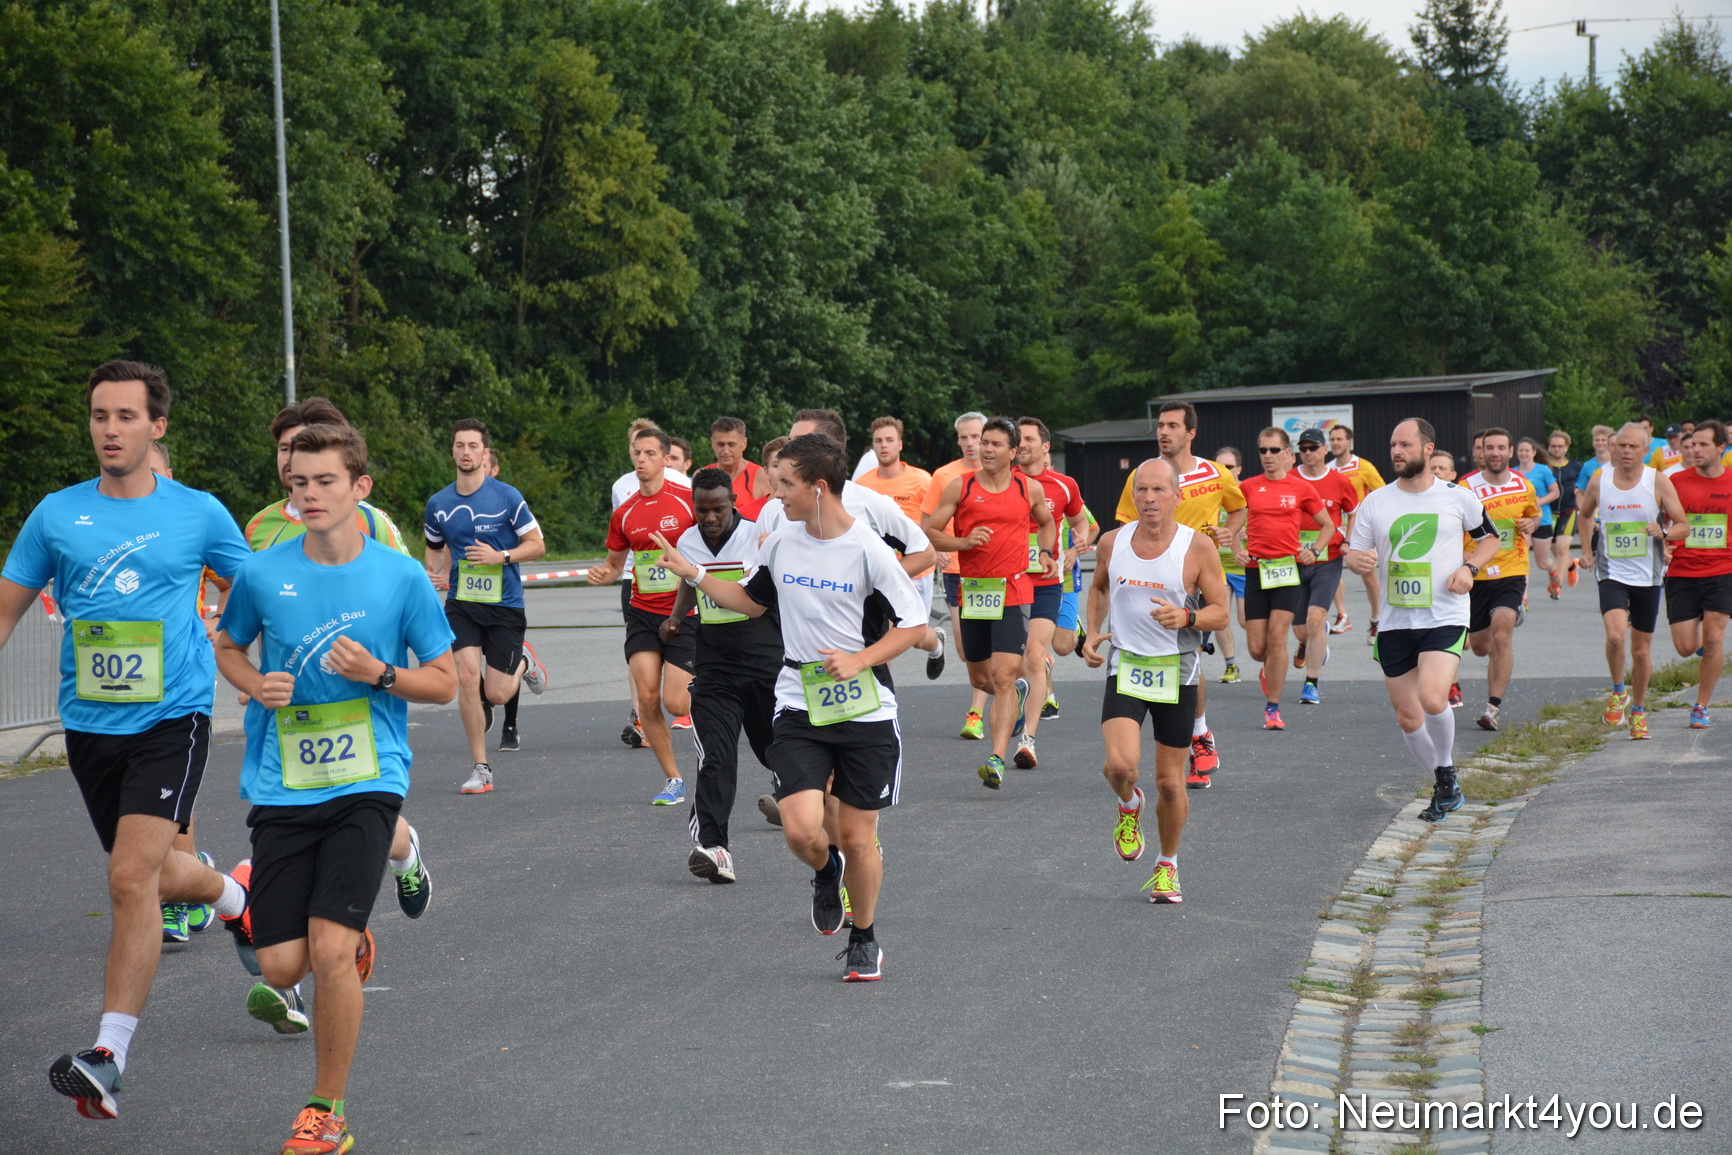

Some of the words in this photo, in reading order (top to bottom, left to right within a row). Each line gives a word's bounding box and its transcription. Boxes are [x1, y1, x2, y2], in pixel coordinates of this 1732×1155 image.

[1189, 482, 1223, 498] BÖGL
[1505, 495, 1529, 506] BÖGL
[1690, 527, 1723, 539] 1479
[1615, 536, 1638, 548] 591
[77, 566, 99, 592] Team
[97, 541, 135, 566] Schick
[135, 531, 160, 544] Bau
[647, 567, 666, 581] 28
[1265, 566, 1294, 580] 1587
[466, 576, 492, 591] 940
[782, 573, 854, 593] DELPHI
[1128, 579, 1168, 590] KLEBL
[1394, 579, 1421, 595] 100
[967, 593, 1001, 608] 1366
[284, 645, 304, 669] Team
[302, 618, 340, 645] Schick
[340, 610, 366, 622] Bau
[91, 653, 143, 679] 802
[1129, 668, 1164, 688] 581
[818, 679, 863, 707] 285
[298, 734, 356, 765] 822
